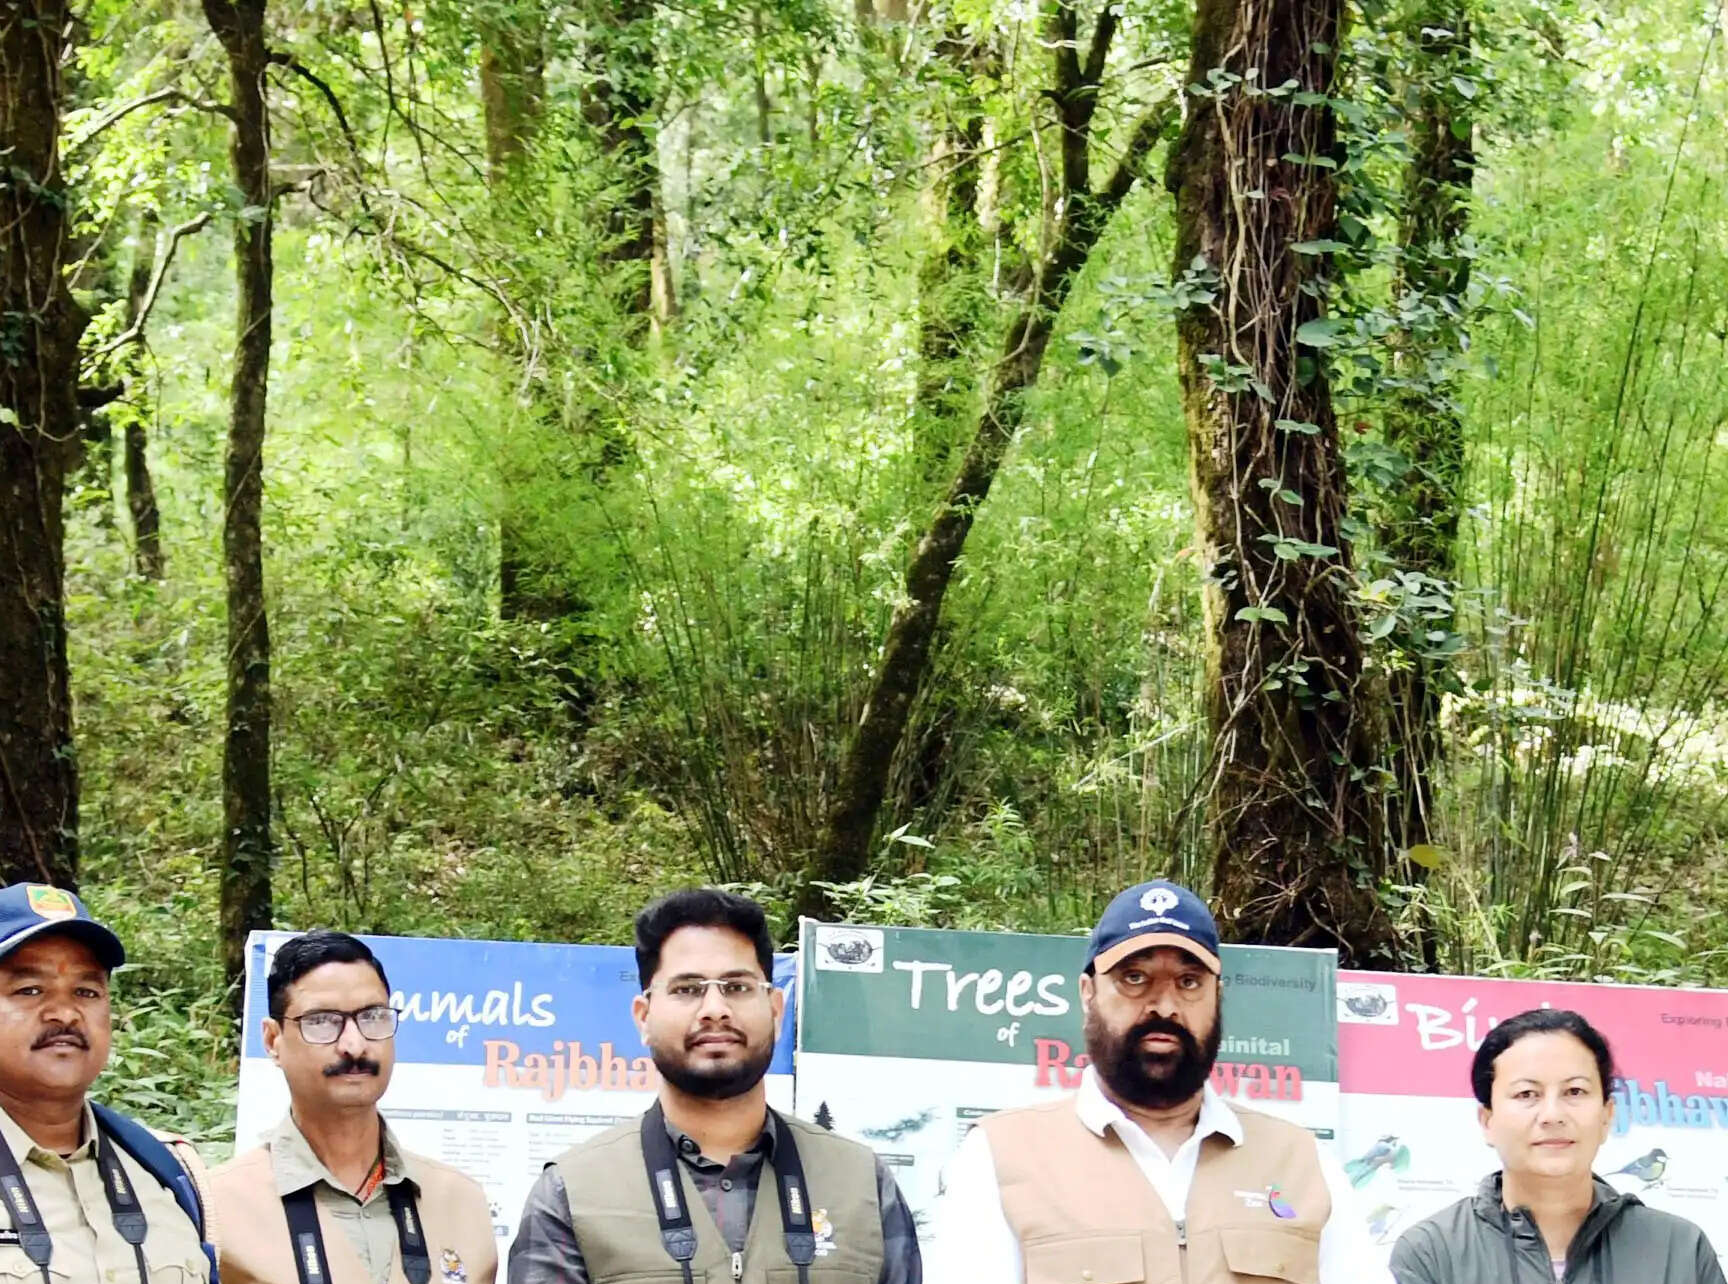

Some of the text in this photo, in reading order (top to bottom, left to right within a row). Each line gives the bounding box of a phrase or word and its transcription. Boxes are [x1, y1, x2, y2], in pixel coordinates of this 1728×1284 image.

[892, 959, 1070, 1017] Trees
[1235, 973, 1318, 993] Biodiversity
[389, 980, 556, 1028] mmals
[996, 1021, 1021, 1048] of
[1660, 1013, 1723, 1029] Exploring
[445, 1024, 471, 1049] of
[1218, 1034, 1291, 1057] ainital
[482, 1039, 658, 1103] Rajbha
[9, 1186, 31, 1214] Nikon
